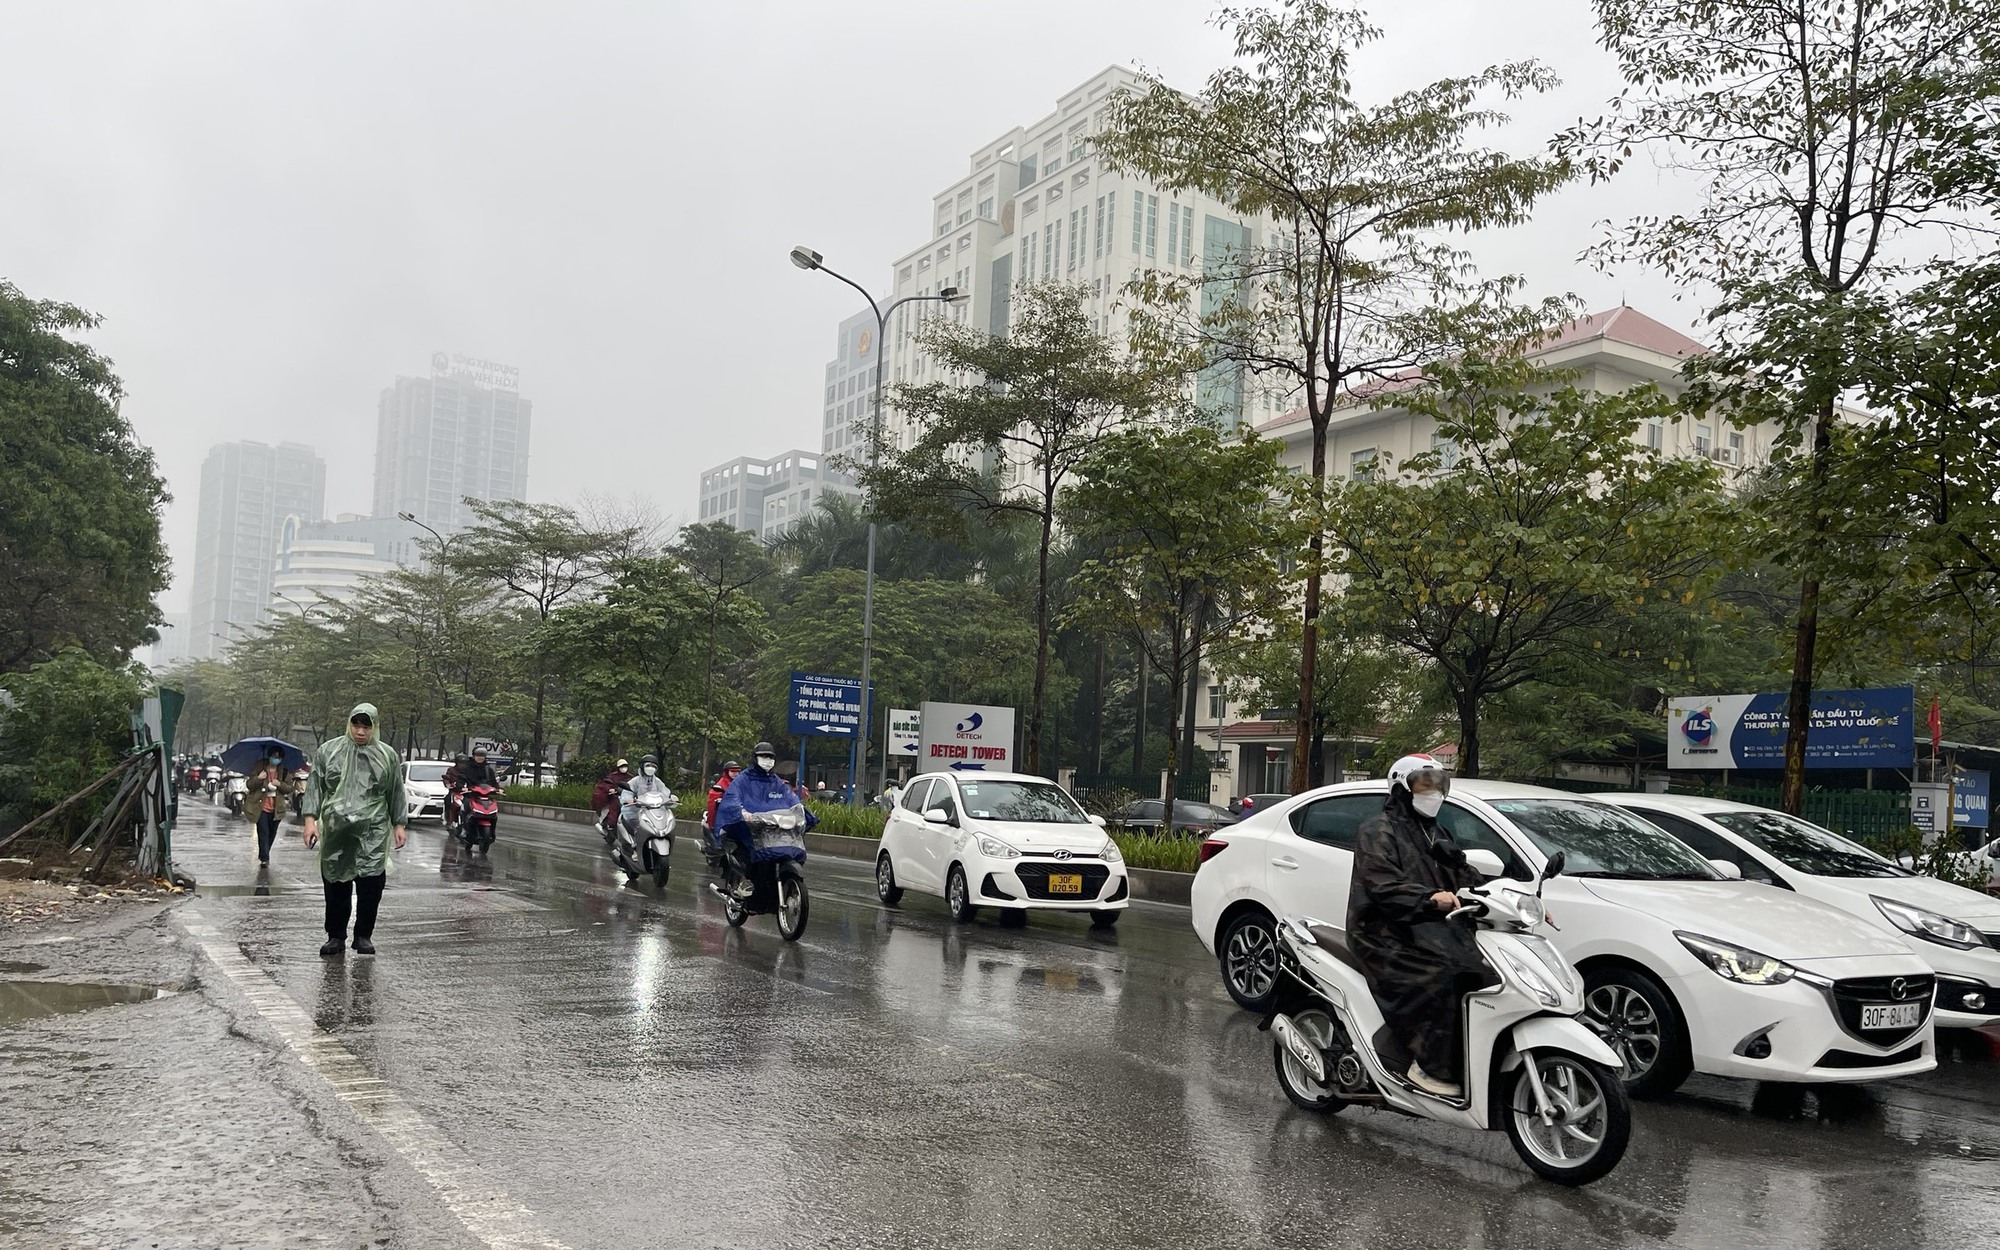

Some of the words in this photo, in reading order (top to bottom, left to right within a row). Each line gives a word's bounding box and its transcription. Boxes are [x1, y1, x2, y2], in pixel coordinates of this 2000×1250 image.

[800, 684, 812, 695] TỔNG
[814, 688, 823, 697] CỤC
[799, 699, 808, 708] CỤC
[798, 711, 808, 720] CỤC
[1744, 712, 1768, 720] CÔNG
[1688, 720, 1711, 730] ILS
[1840, 720, 1853, 728] VỤ
[930, 744, 968, 758] DETECH
[972, 746, 1006, 760] TOWER
[1965, 794, 1986, 810] QUAN
[1475, 1000, 1495, 1010] HONDA
